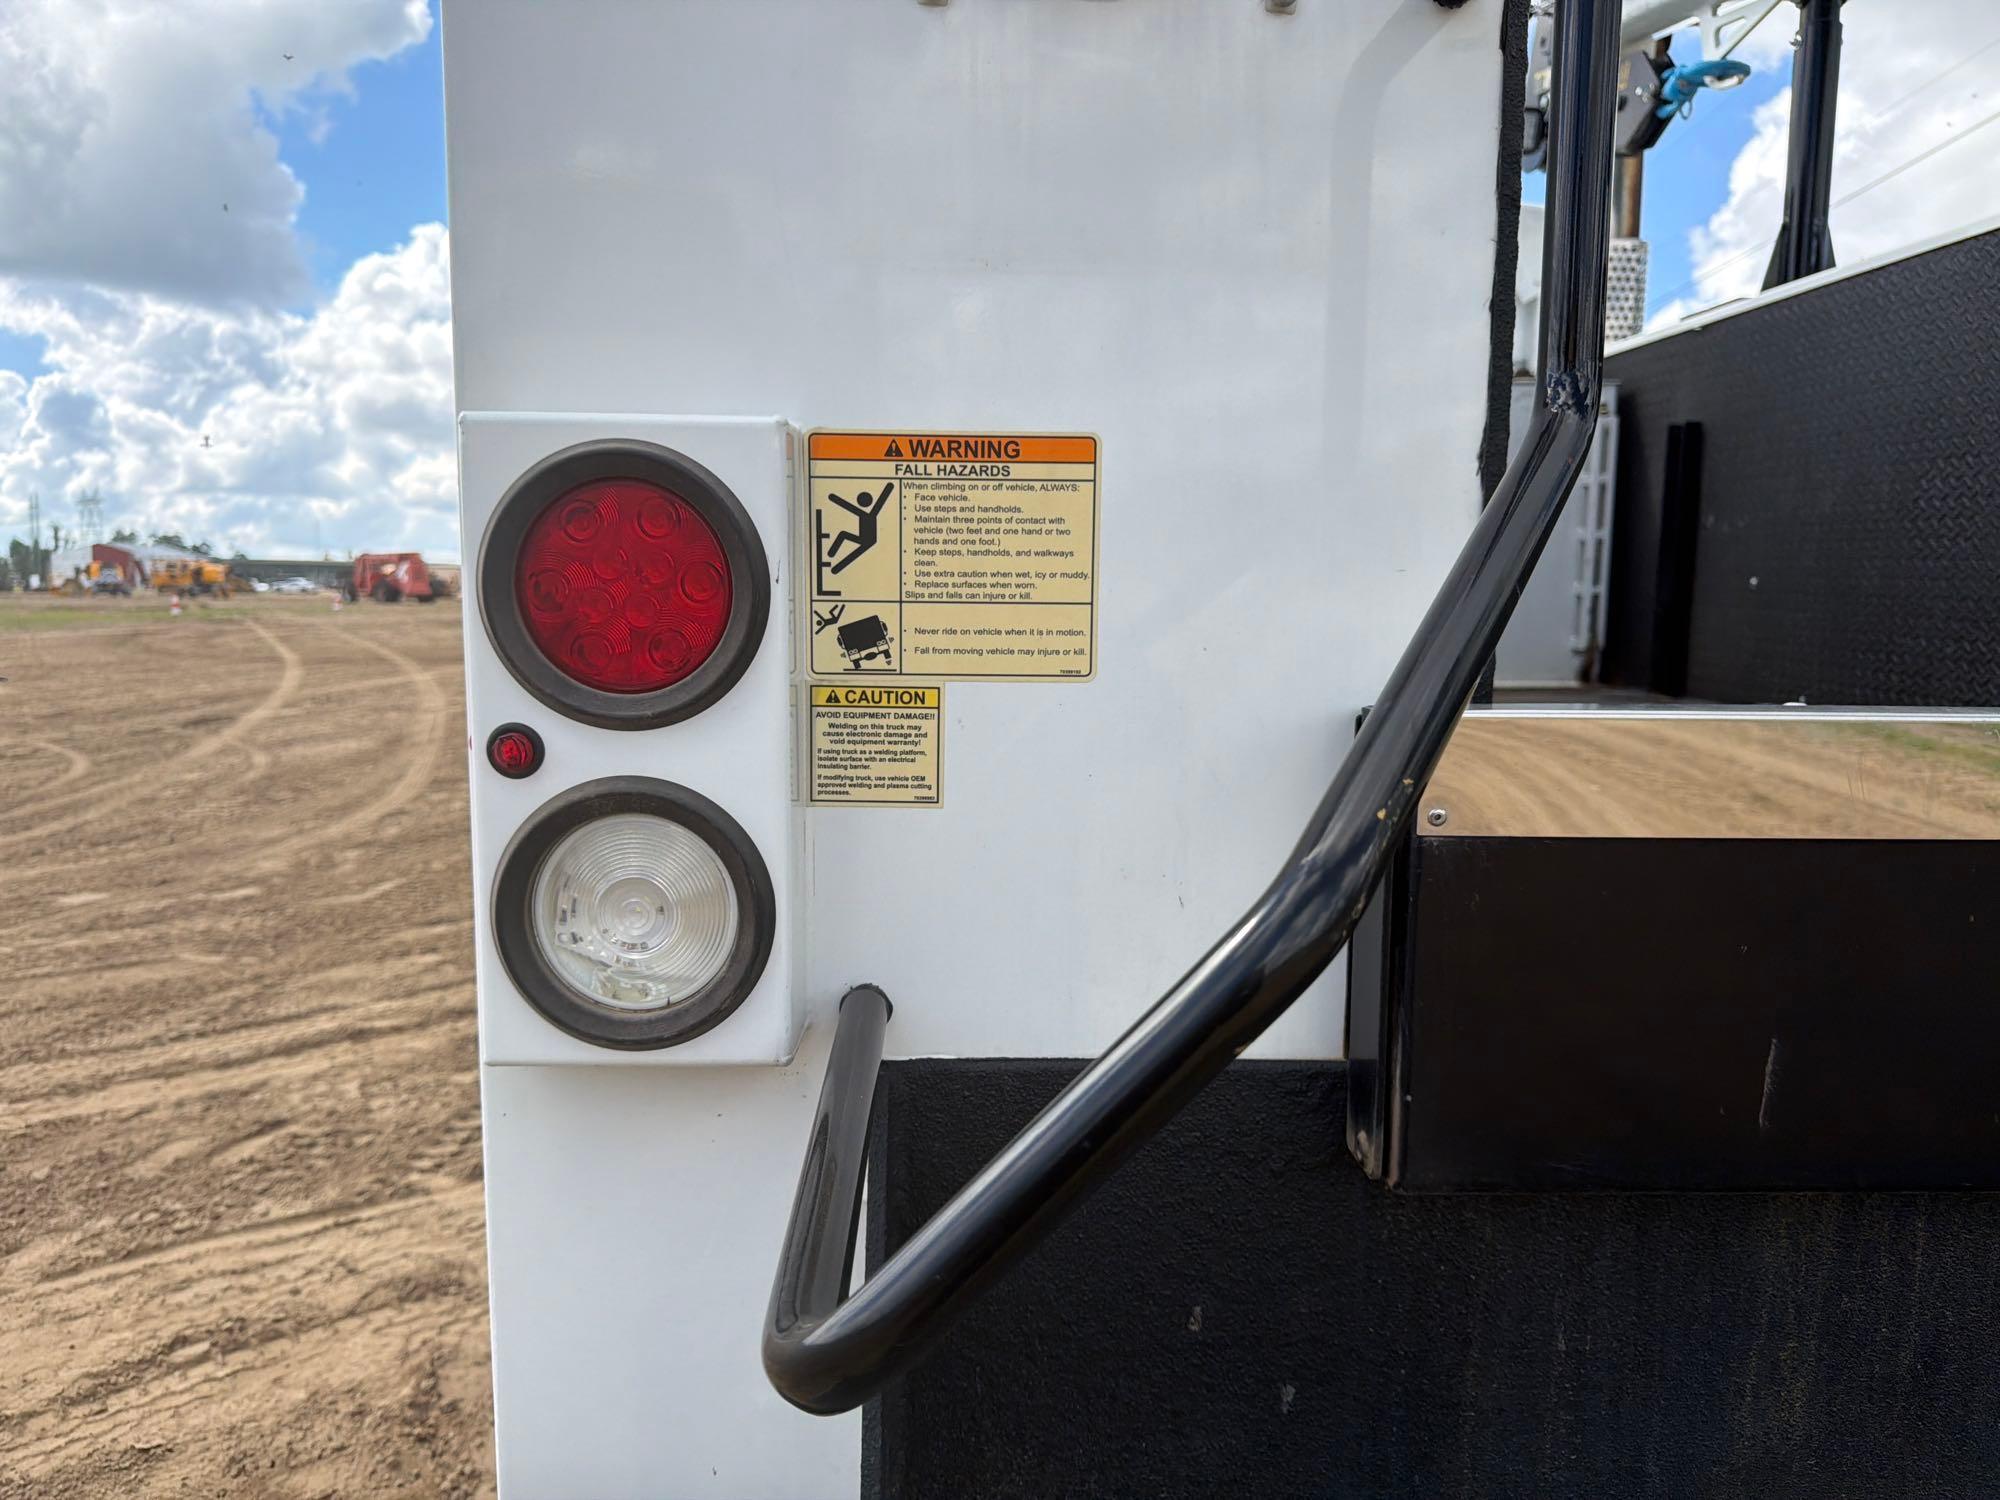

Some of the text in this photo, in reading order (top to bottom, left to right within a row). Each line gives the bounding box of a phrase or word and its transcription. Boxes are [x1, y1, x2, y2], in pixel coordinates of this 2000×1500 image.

[909, 439, 1021, 459] WARNING
[895, 464, 1011, 477] FALL HAZARDS
[931, 483, 966, 492] climbing
[1005, 484, 1038, 492] vehicle,
[938, 494, 970, 502] vehicle.
[934, 505, 956, 514] steps
[978, 505, 1024, 513] handholds.
[977, 516, 1002, 526] points
[946, 527, 964, 536] (two
[979, 538, 1001, 547] foot.)
[915, 548, 936, 558] Keep
[939, 549, 964, 558] steps,
[967, 549, 1013, 558] handholds,
[1034, 549, 1074, 558] walkways
[915, 570, 931, 578] Use
[1016, 571, 1032, 579] wet,
[1035, 571, 1046, 580] icy
[1060, 571, 1090, 581] muddy.
[915, 581, 949, 590] Replace
[905, 591, 925, 600] Slips
[946, 591, 963, 599] falls
[983, 591, 1006, 601] injure
[1020, 592, 1032, 600] kill.
[953, 648, 983, 657] moving
[1038, 648, 1060, 658] injure
[845, 690, 925, 704] CAUTION
